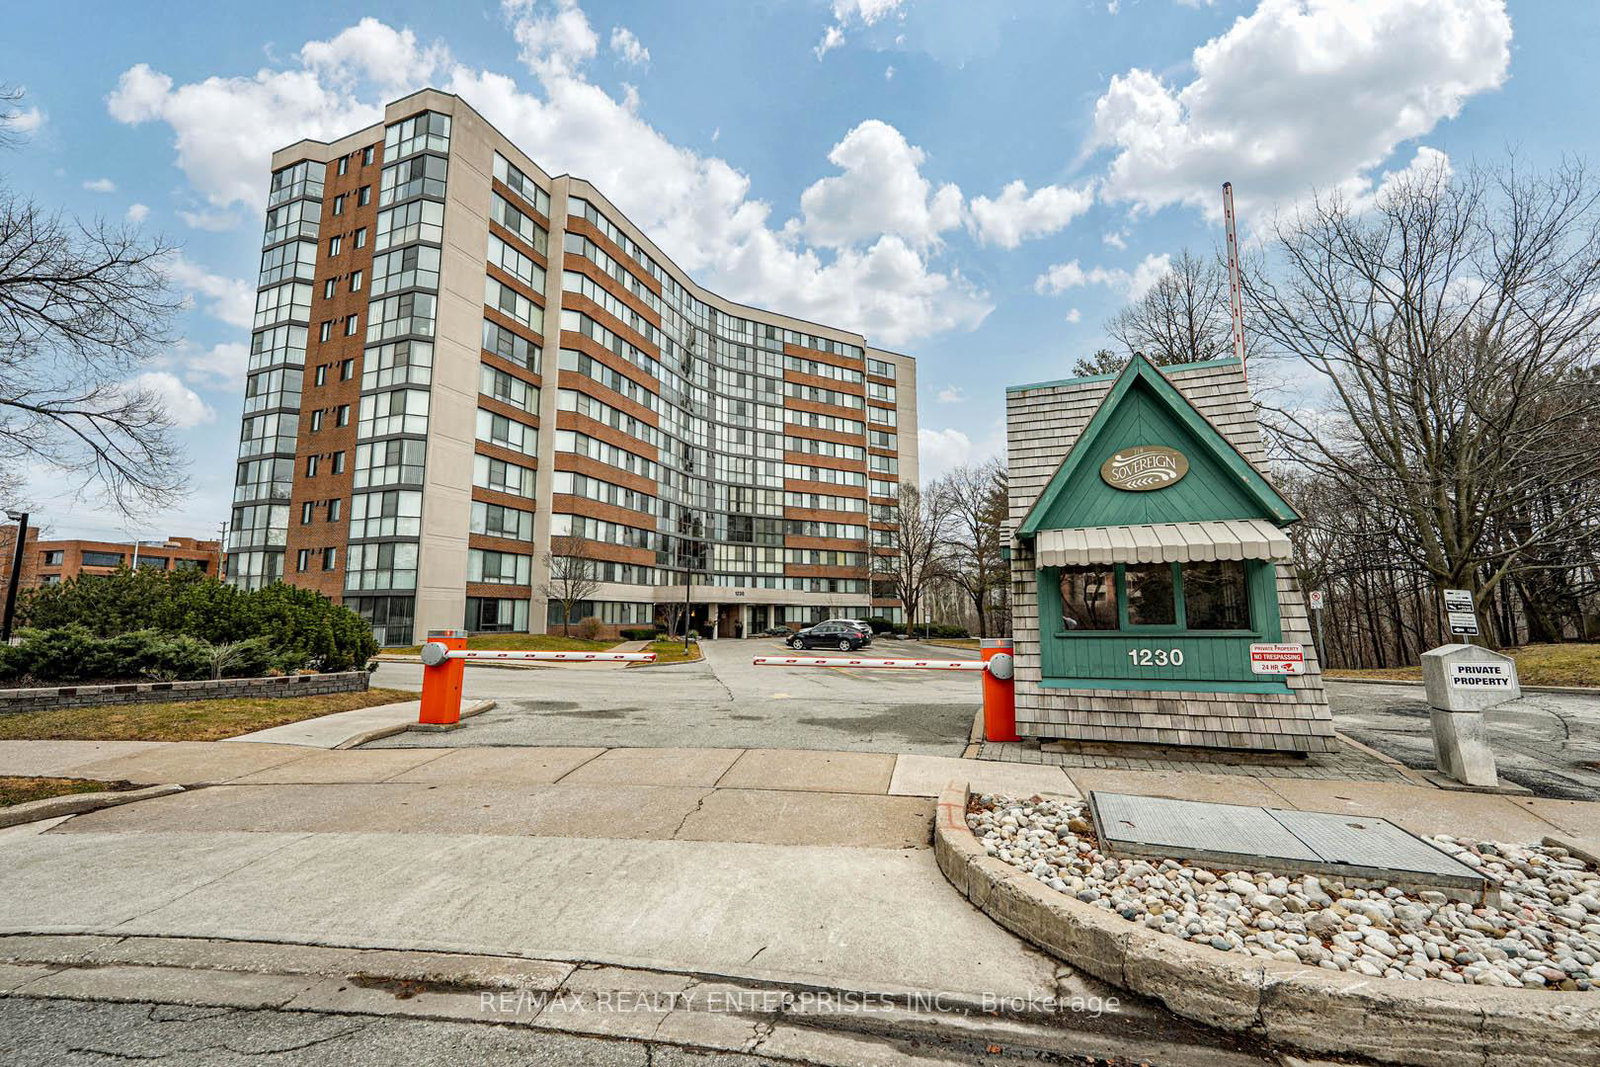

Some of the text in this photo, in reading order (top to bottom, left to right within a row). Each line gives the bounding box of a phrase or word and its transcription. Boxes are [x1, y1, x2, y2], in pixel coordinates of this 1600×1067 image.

[1111, 455, 1177, 480] SOVEREIGN
[1128, 648, 1184, 667] 1230
[1263, 653, 1301, 661] TRESPASSING
[1458, 666, 1501, 674] PRIVATE
[1454, 677, 1508, 685] PROPERTY
